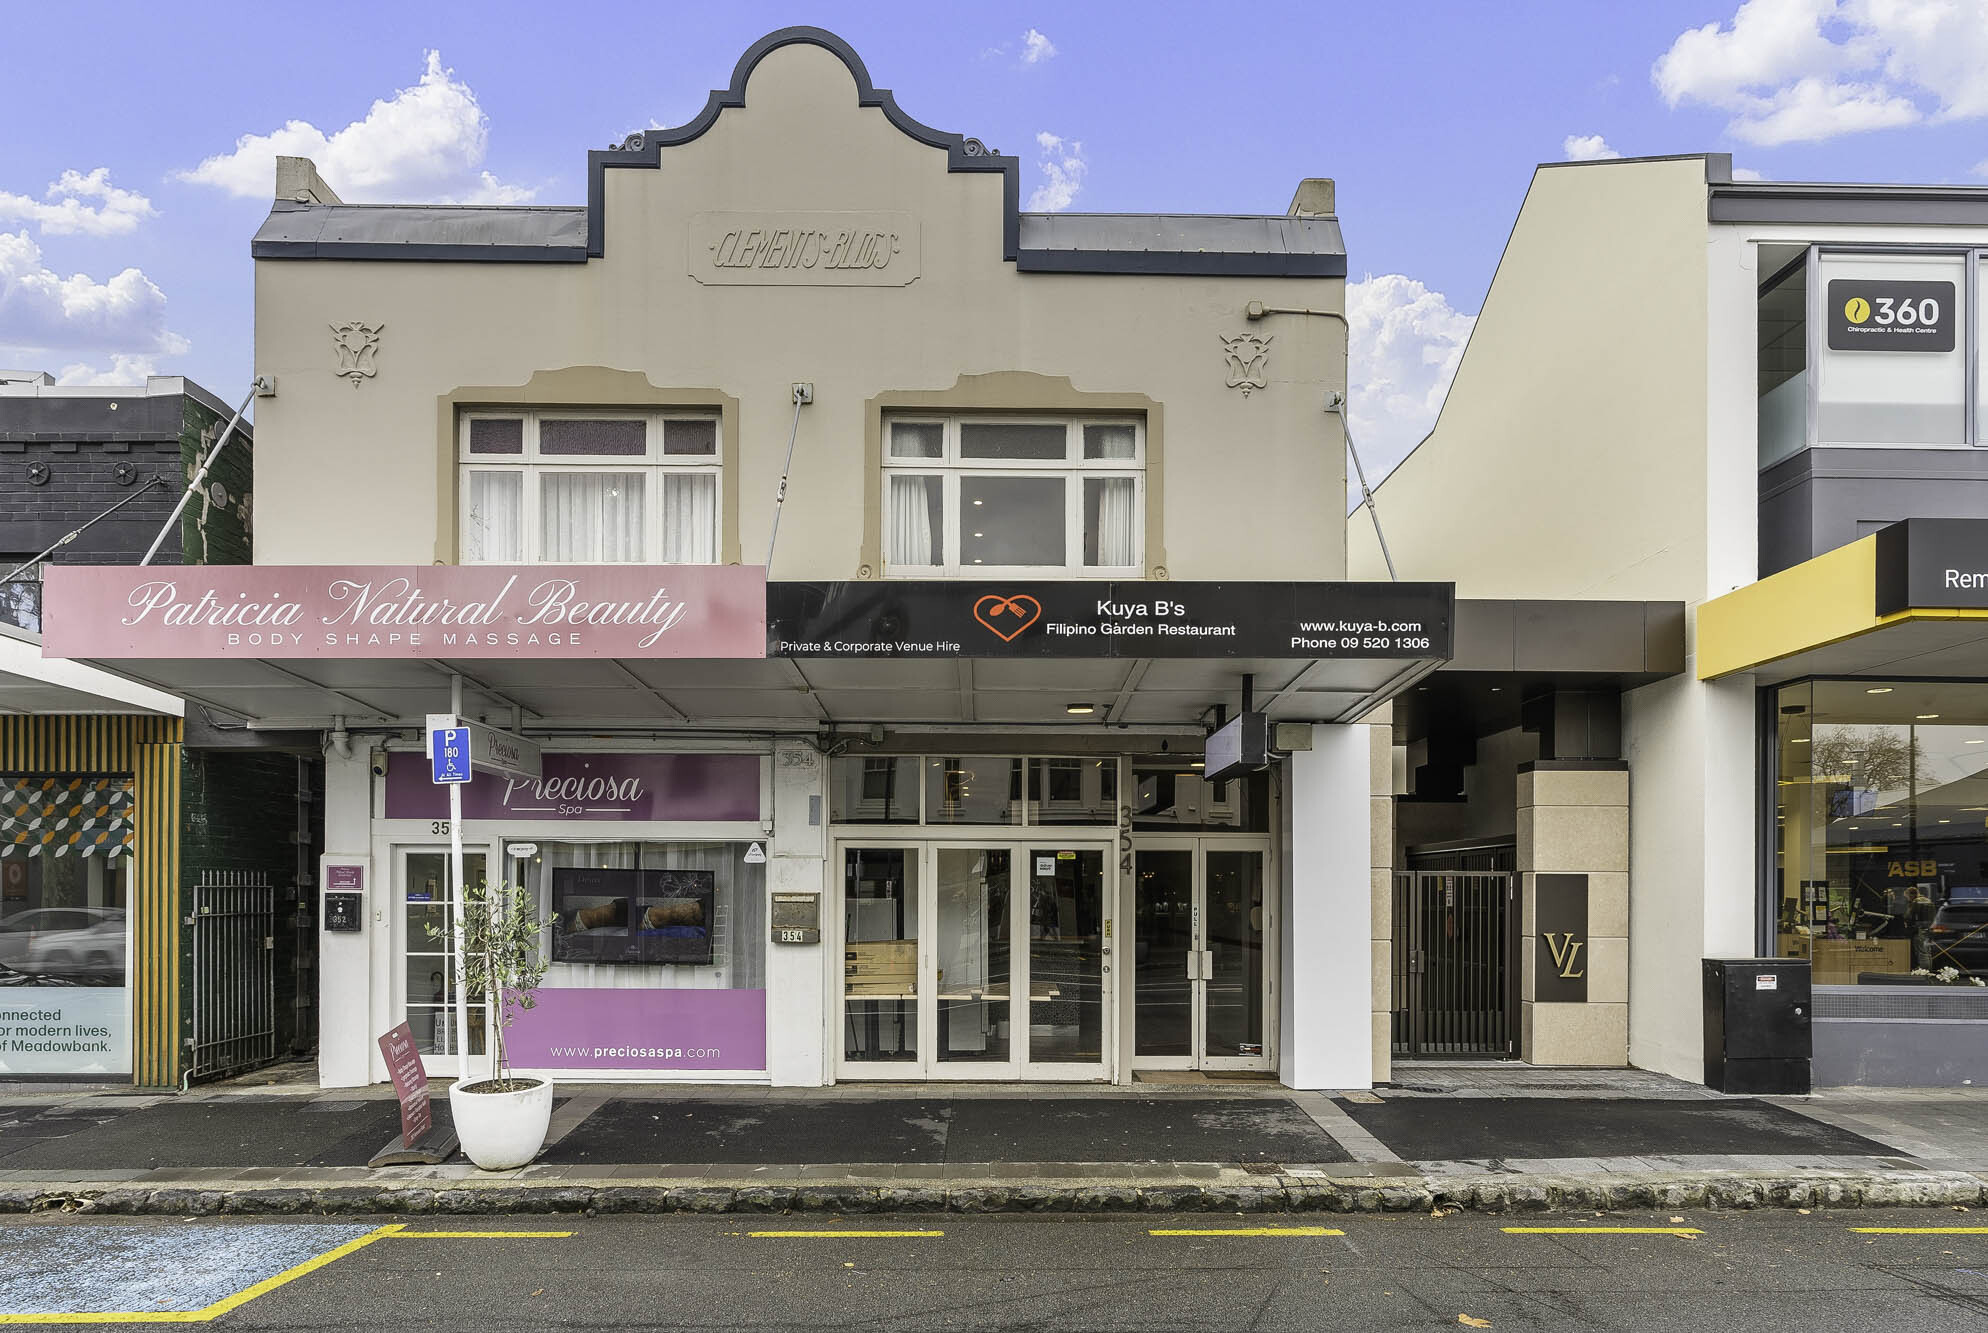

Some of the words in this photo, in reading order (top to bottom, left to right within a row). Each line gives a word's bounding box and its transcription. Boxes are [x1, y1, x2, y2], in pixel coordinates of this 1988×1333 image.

[1874, 297, 1940, 325] 360
[1847, 326, 1886, 334] Chiropractic
[121, 581, 304, 626] Patricia
[322, 575, 518, 626] Natural
[517, 579, 687, 649] Beauty
[1097, 600, 1148, 619] Kuya
[1155, 600, 1186, 616] B's
[1046, 623, 1097, 637] Filipino
[1100, 623, 1154, 635] Garden
[1158, 623, 1236, 636] Restaurant
[1300, 620, 1422, 634] www.kuya-b.com
[228, 633, 304, 645] BODY
[325, 633, 422, 645] SHAPE
[443, 633, 582, 645] MASSAGE
[1291, 637, 1337, 649] Phone
[1340, 637, 1359, 649] 09
[1362, 637, 1390, 649] 520
[1394, 637, 1430, 649] 1306
[780, 641, 821, 652] Private
[823, 641, 832, 652] &
[833, 641, 893, 653] Corporate
[895, 641, 934, 652] Venue
[936, 641, 961, 652] Hire
[445, 730, 457, 747] P
[444, 747, 459, 758] 180
[782, 752, 814, 767] 354
[558, 803, 583, 817] Spa
[431, 821, 450, 835] 35
[1120, 805, 1133, 875] 354
[1888, 860, 1937, 878] ASB
[782, 931, 803, 942] 354
[1854, 945, 1884, 953] Welcome
[0, 1009, 61, 1021] nnected
[15, 1025, 72, 1037] modern
[75, 1025, 112, 1038] lives,
[0, 1040, 8, 1052] f
[11, 1040, 112, 1052] Meadowbank.
[550, 1045, 721, 1059] www.preciosaspa.com
